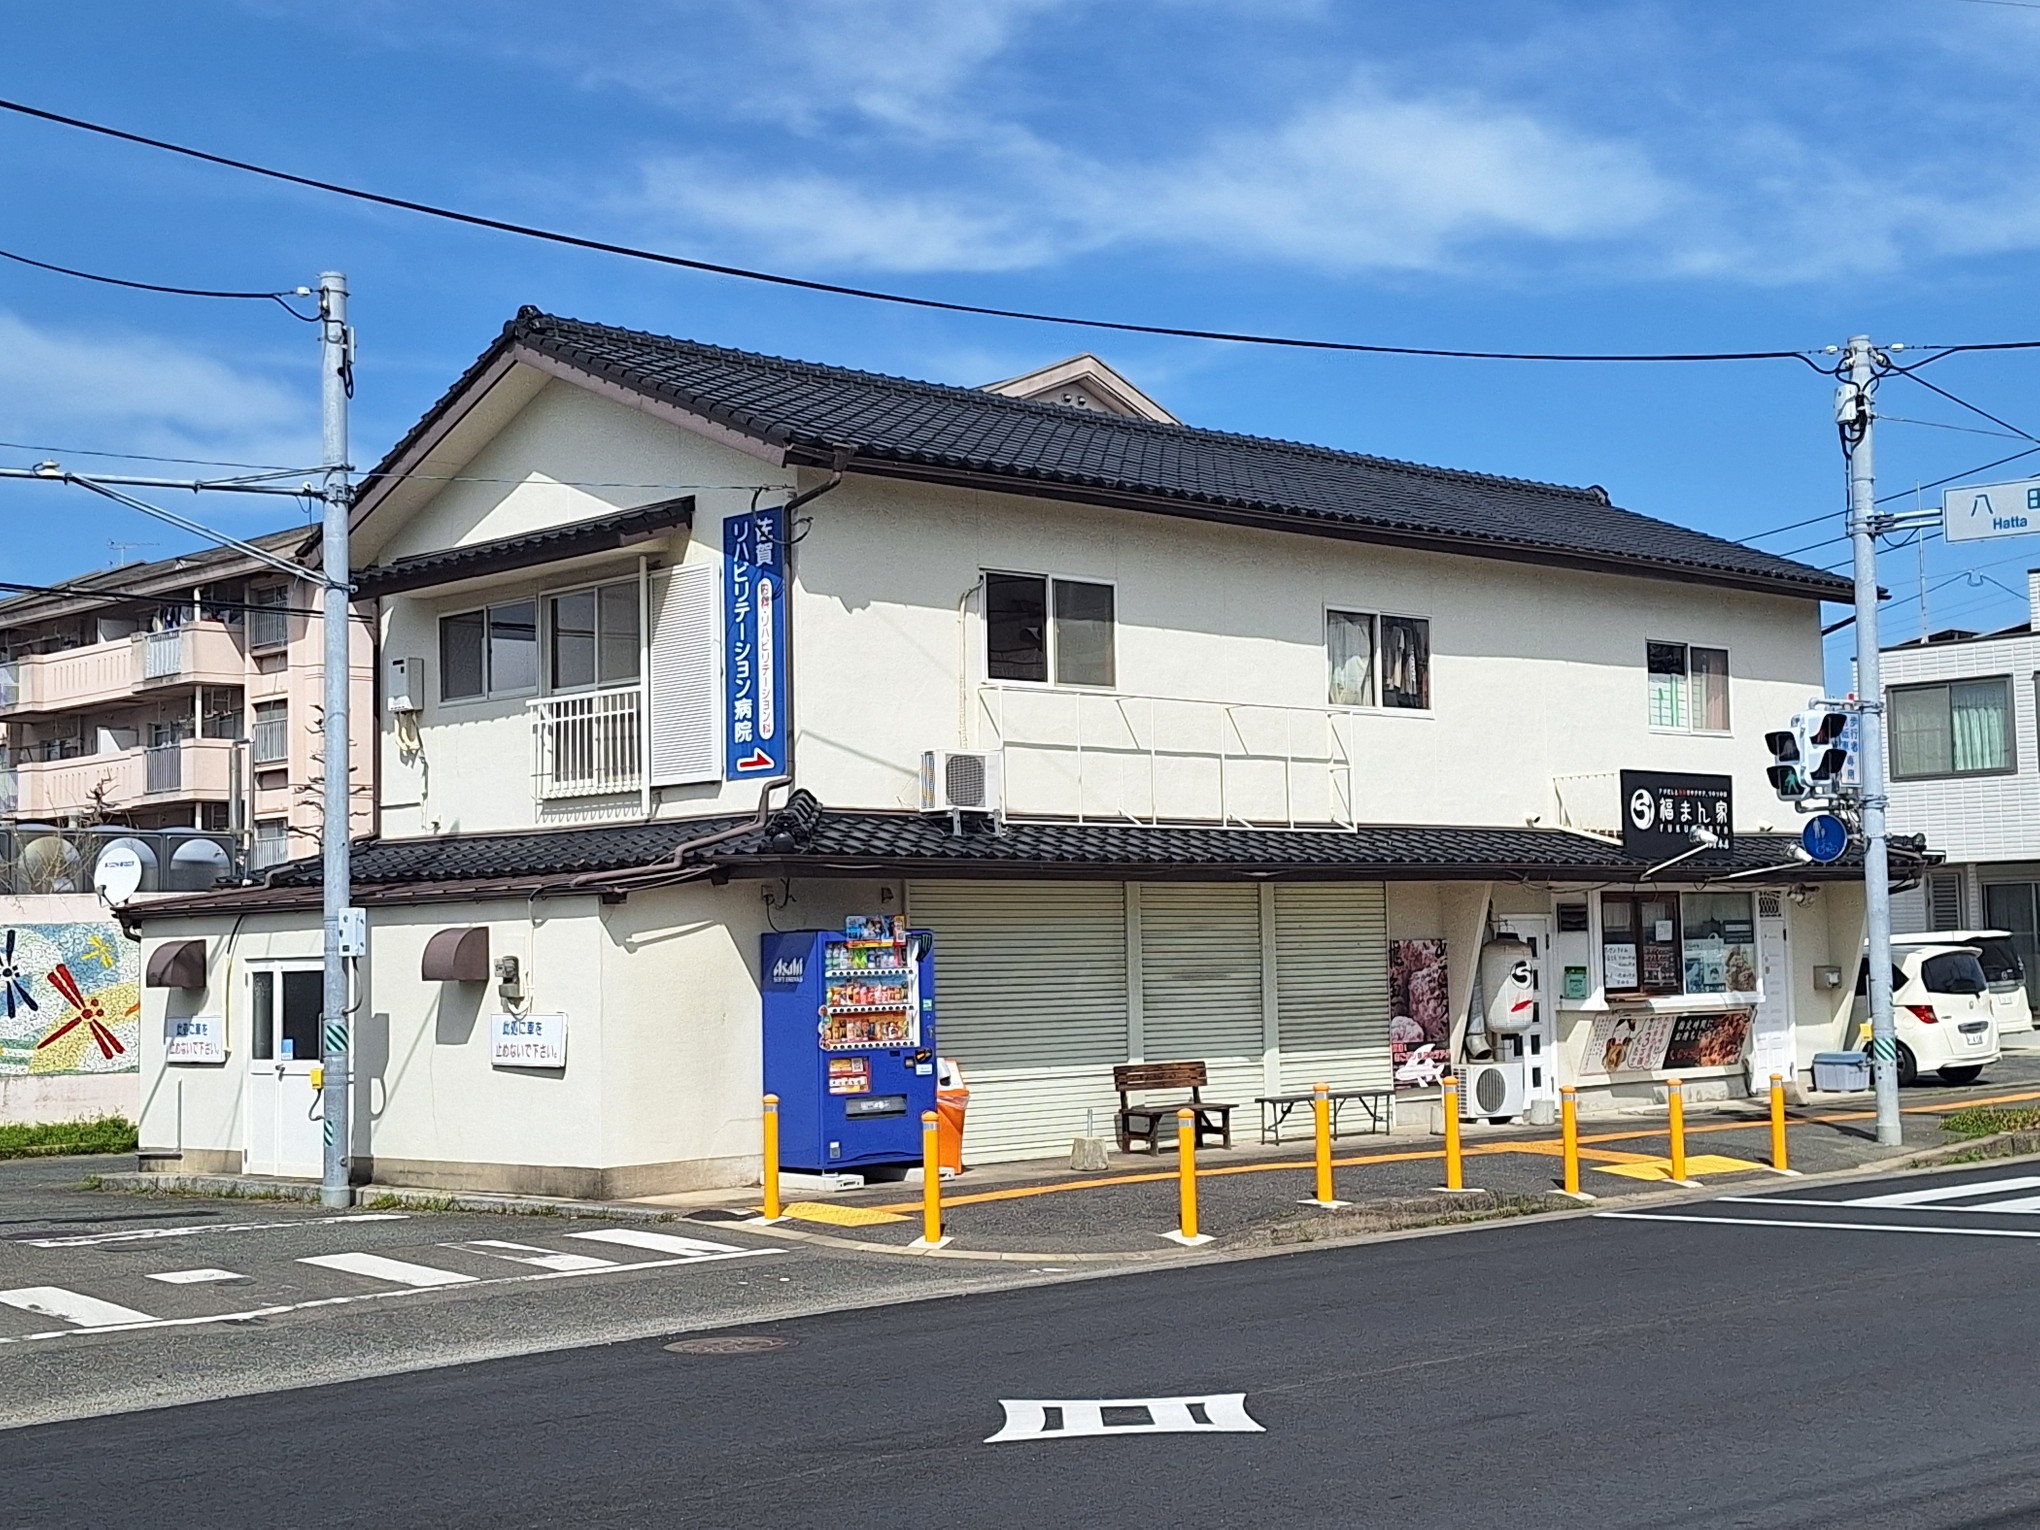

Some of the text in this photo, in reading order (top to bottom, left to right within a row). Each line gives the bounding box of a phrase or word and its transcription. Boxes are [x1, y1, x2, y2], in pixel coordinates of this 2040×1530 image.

[1993, 516, 2028, 530] Hatta
[755, 517, 774, 567] 佐賀
[733, 521, 753, 743] リハビリテーション病院
[1659, 797, 1728, 824] 福まん家
[773, 957, 803, 976] Asahi
